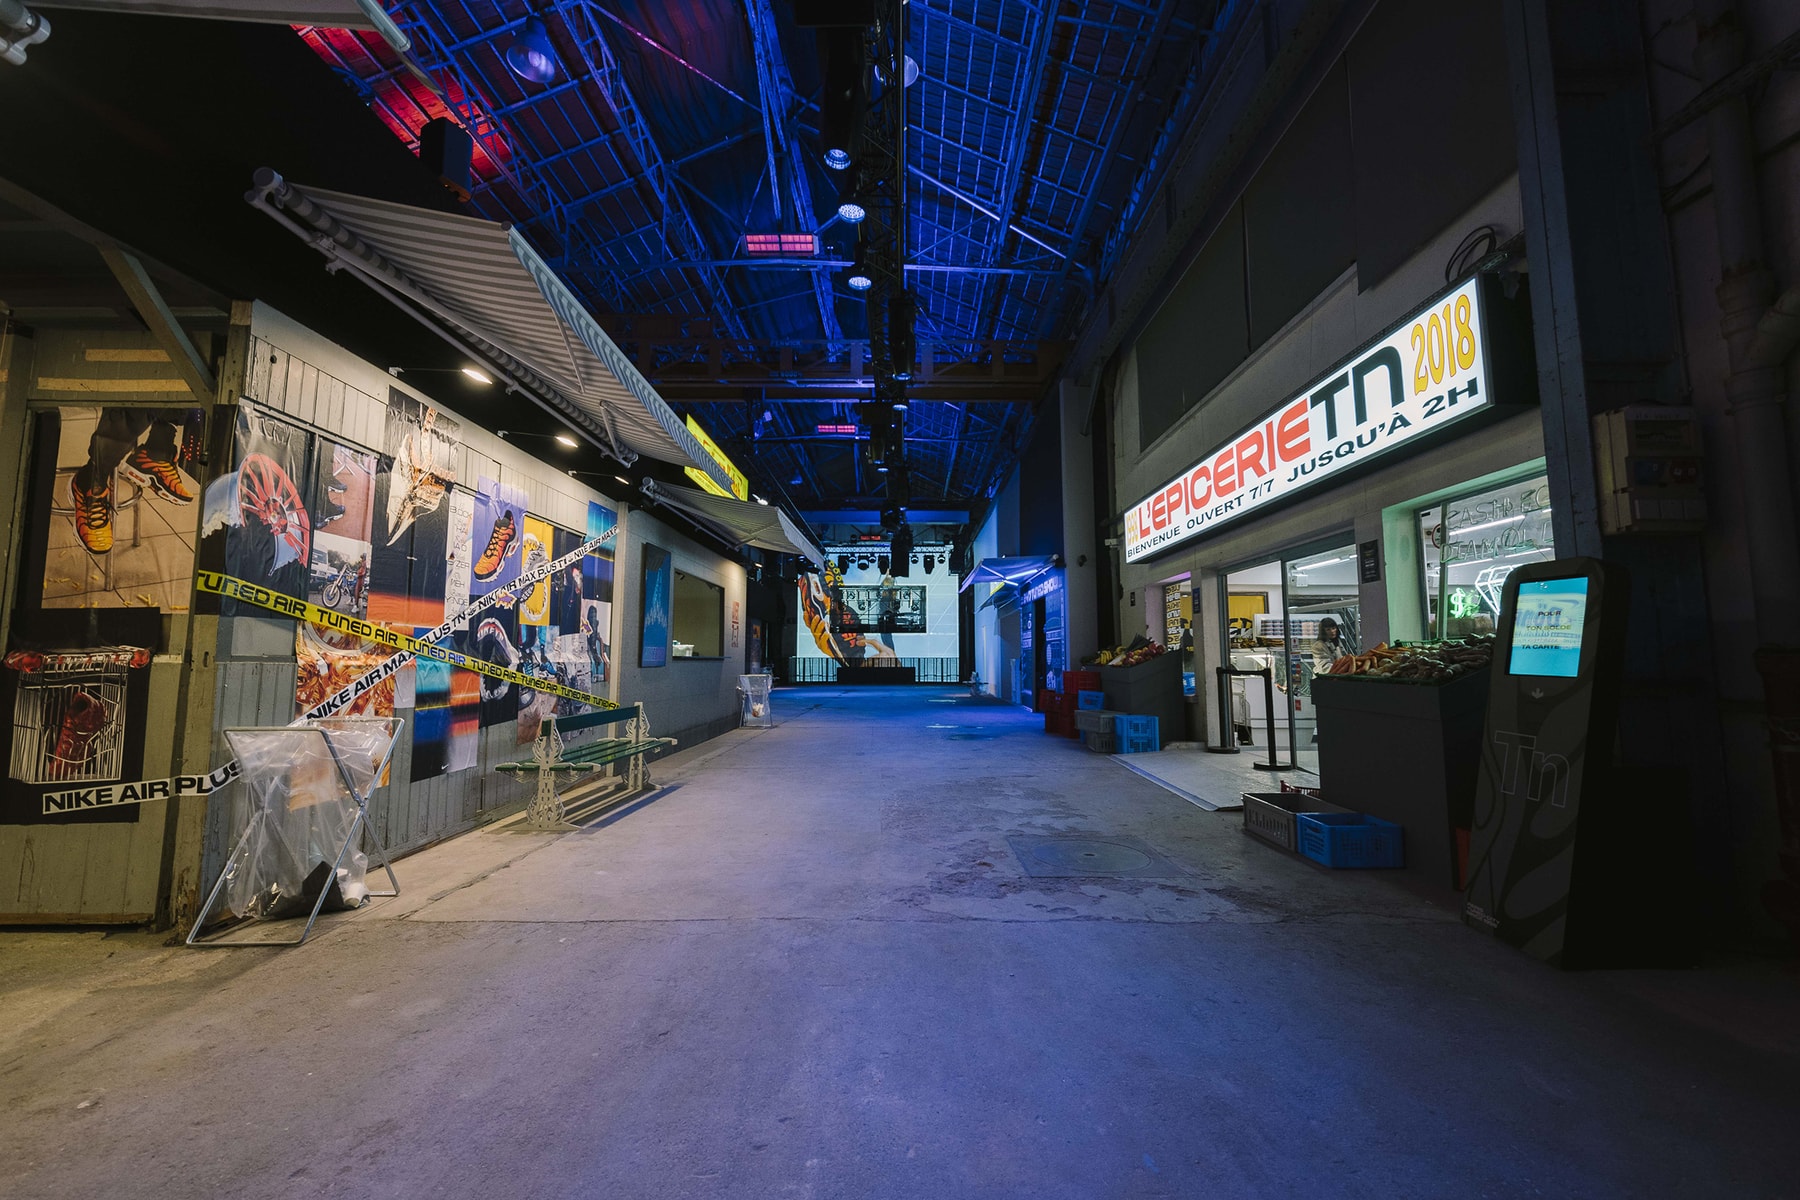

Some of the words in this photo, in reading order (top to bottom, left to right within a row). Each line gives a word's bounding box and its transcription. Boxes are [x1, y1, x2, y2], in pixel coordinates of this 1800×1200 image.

[1410, 293, 1476, 396] 2018
[1128, 525, 1181, 558] BIENVENUE
[1186, 494, 1244, 530] OUVERT
[1249, 478, 1276, 502] 7/7
[1286, 410, 1411, 483] JUSQU'À
[1422, 377, 1479, 421] 2H
[199, 573, 269, 604] TUNED
[273, 595, 306, 617] AIR
[317, 609, 372, 637] TUNED
[375, 629, 398, 646] AIR
[405, 637, 446, 660] TUNED
[448, 653, 466, 667] AIR
[471, 658, 501, 678] TUNED
[503, 670, 517, 682] AIR
[521, 675, 545, 690] TUNED
[546, 682, 557, 692] AIR
[561, 687, 580, 700] TUNED
[581, 692, 591, 703] AIR
[306, 688, 352, 719] NIKE
[353, 669, 382, 697] AIR
[451, 611, 467, 628] TN
[518, 571, 536, 587] MAX
[588, 538, 601, 549] AIR
[45, 787, 113, 812] NIKE
[118, 780, 170, 803] AIR
